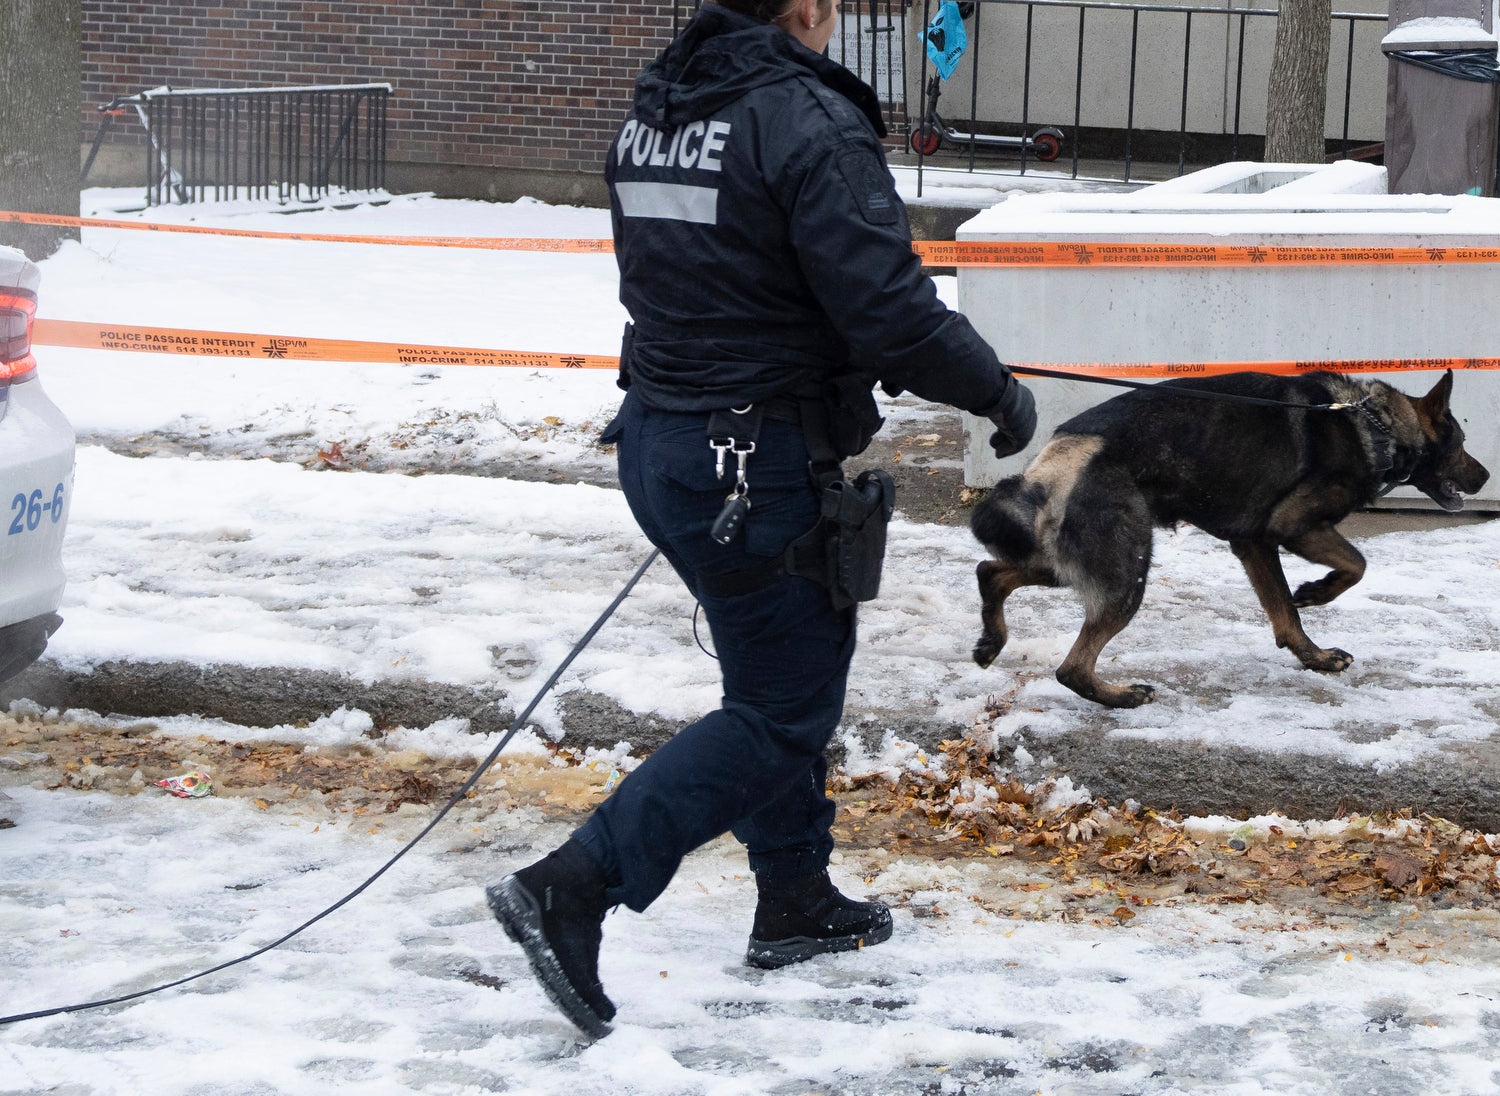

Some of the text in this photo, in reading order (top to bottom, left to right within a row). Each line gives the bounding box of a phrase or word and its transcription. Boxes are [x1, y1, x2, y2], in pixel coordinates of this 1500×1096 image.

[617, 118, 732, 172] POLICE
[100, 331, 256, 348] POLICE PASSAGE INTERDIT
[277, 339, 307, 349] SPVM
[101, 341, 251, 357] INFO-CRIME 514 393-1133
[399, 355, 548, 367] INFO-CRIME 514 393-1133
[8, 482, 64, 536] 26-6
